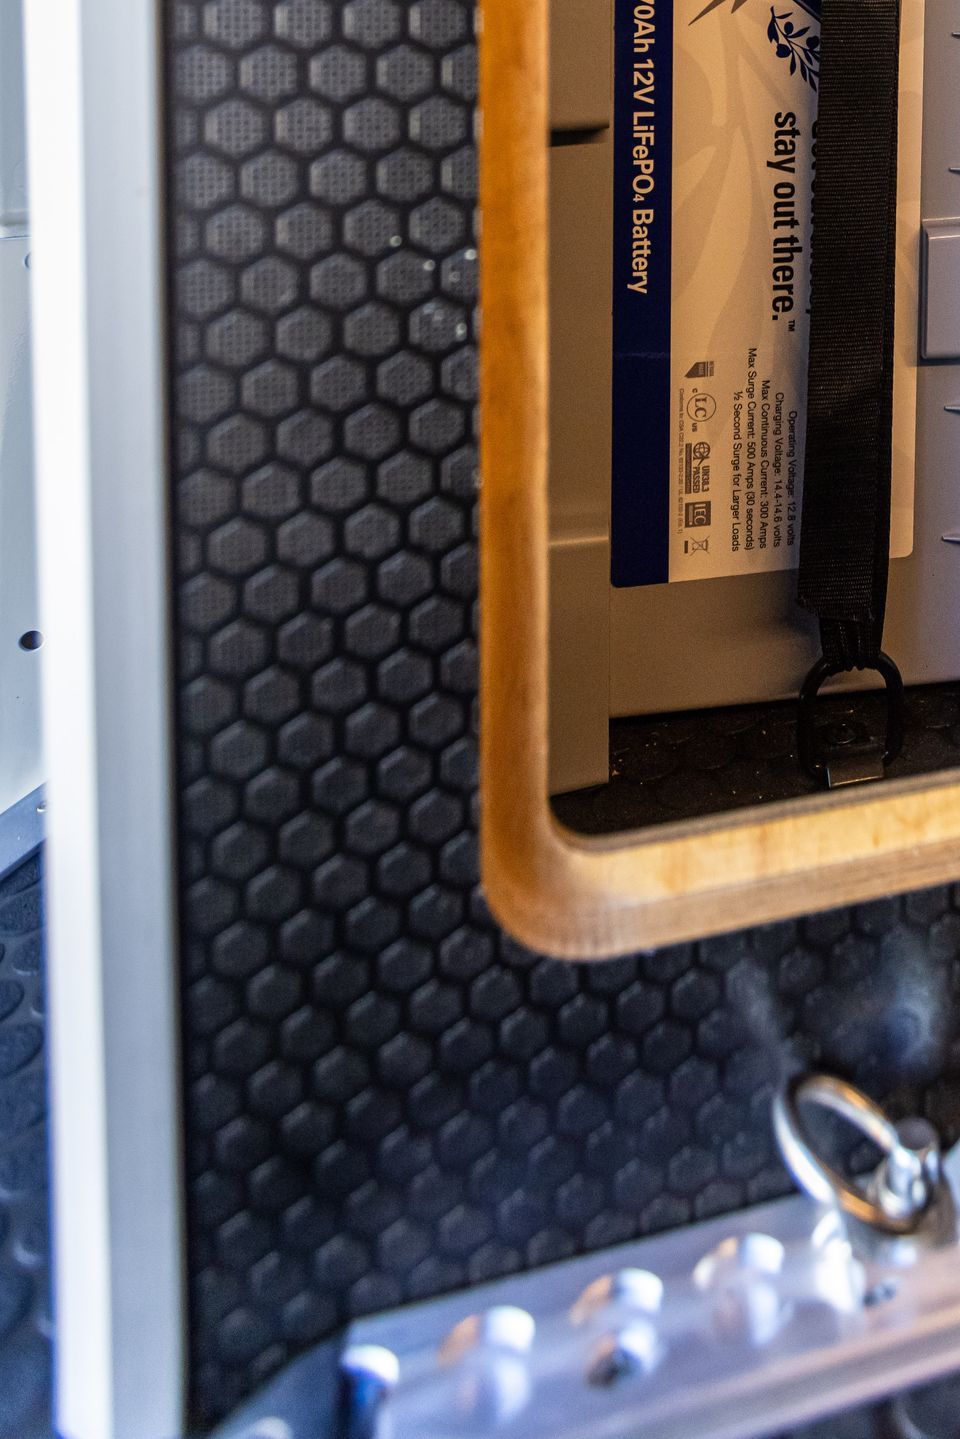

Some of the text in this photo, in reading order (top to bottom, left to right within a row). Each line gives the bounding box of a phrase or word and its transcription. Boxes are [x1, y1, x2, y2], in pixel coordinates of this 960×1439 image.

[632, 59, 655, 104] 12V
[766, 112, 801, 174] stay
[773, 182, 798, 233] out
[627, 209, 654, 294] Battery
[733, 404, 742, 440] Second
[731, 443, 741, 471] Surge
[744, 348, 757, 550] Max Surge Current: 500 Amps (30 seconds)
[758, 380, 770, 549] Max Continuous Current: 300 Amps
[693, 467, 701, 493] PASSED
[701, 466, 709, 493] UN38.3
[732, 473, 741, 486] for
[773, 392, 784, 547] Charging Voltage: 14.4-14.6 volts
[786, 411, 797, 546] Operating Voltage: 12.8 volts
[694, 504, 706, 525] IEC
[731, 489, 741, 519] Larger
[732, 522, 741, 552] Loads
